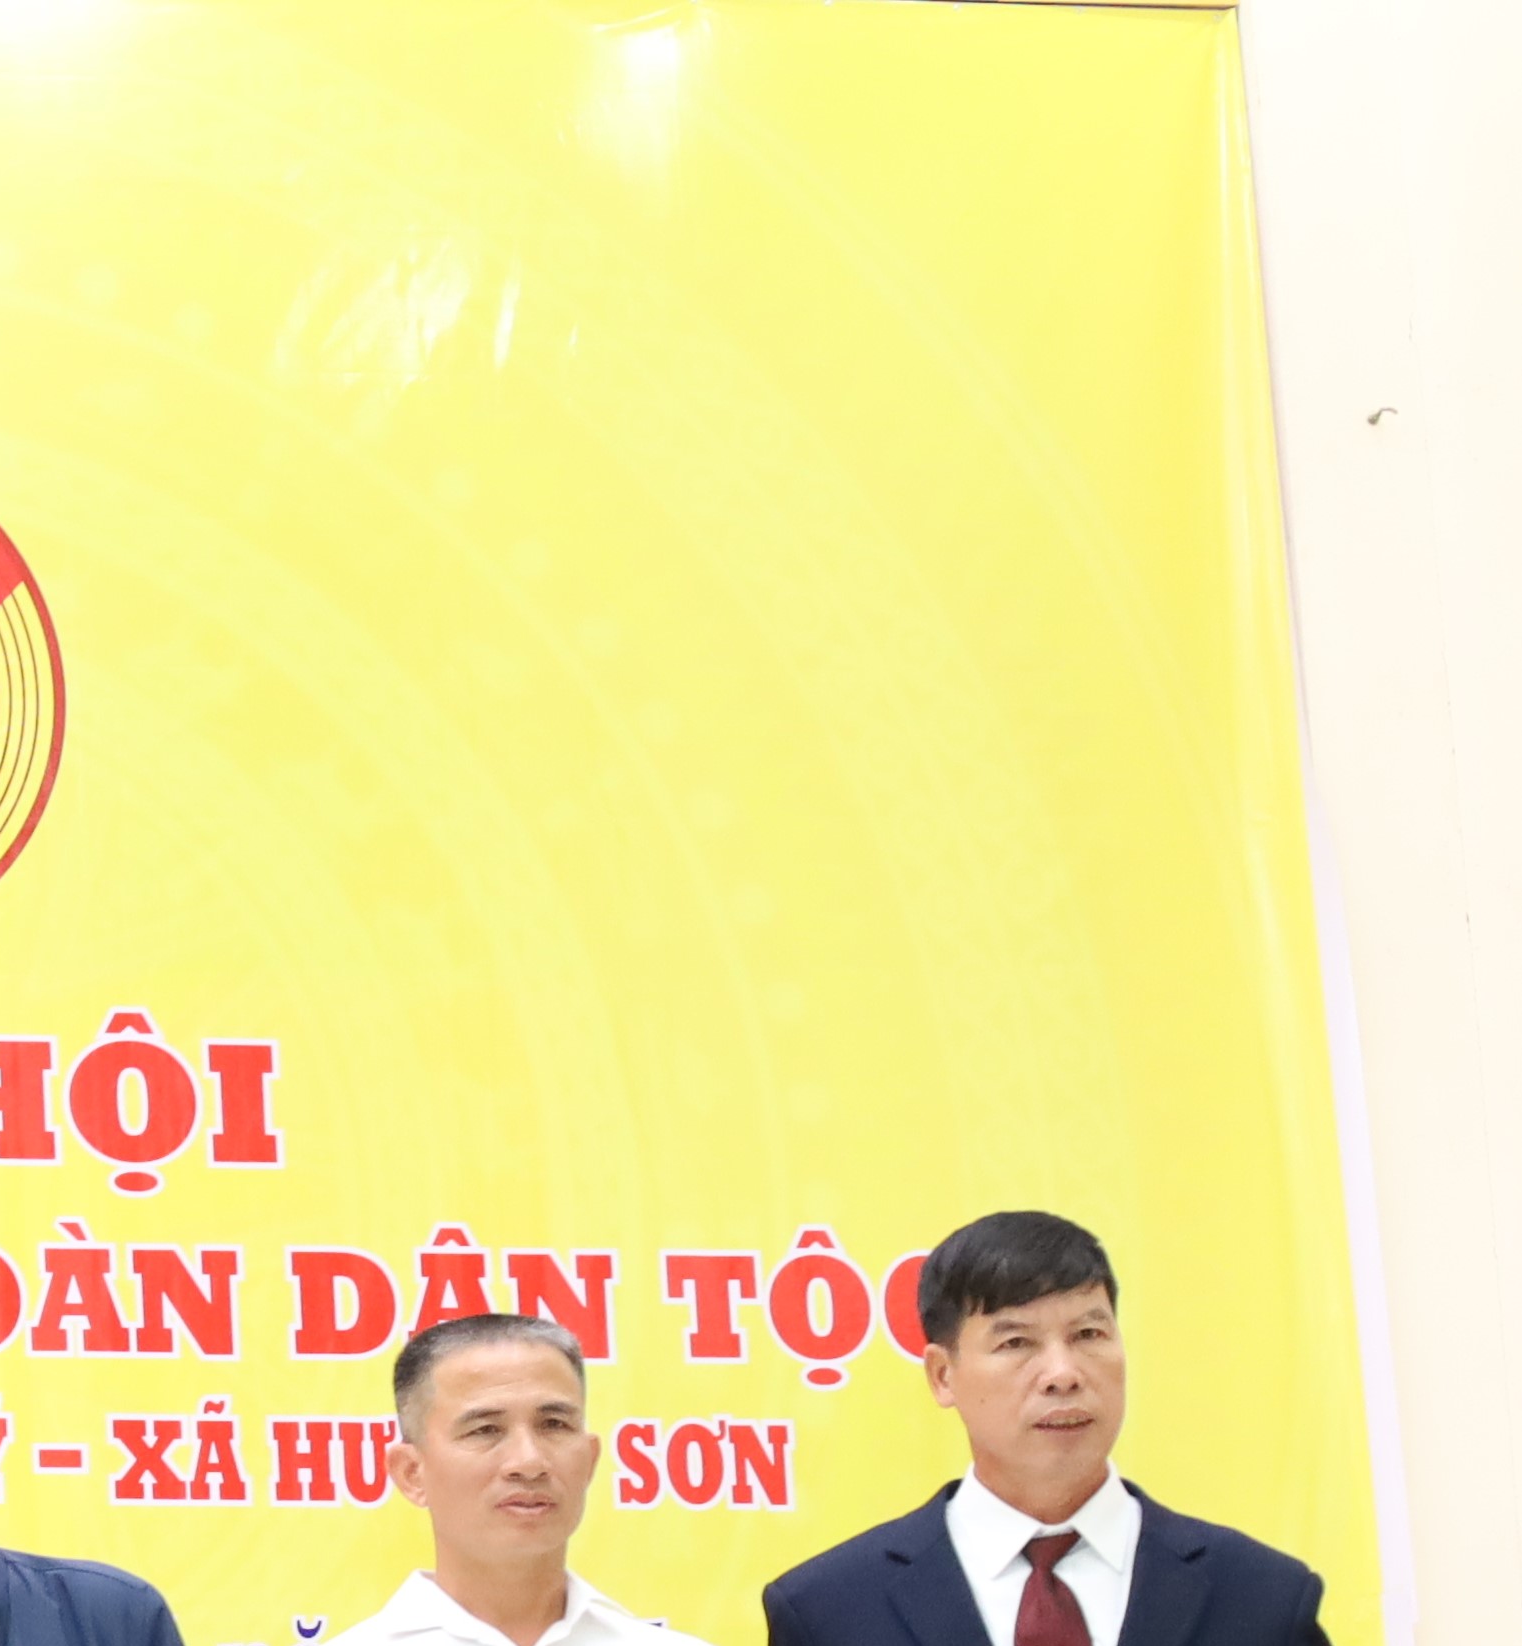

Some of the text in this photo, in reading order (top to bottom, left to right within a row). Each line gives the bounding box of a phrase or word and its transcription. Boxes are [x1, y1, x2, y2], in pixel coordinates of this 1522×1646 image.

[290, 1227, 613, 1360] DÂN
[112, 1400, 247, 1501] XÃ
[616, 1419, 789, 1506] SƠN
